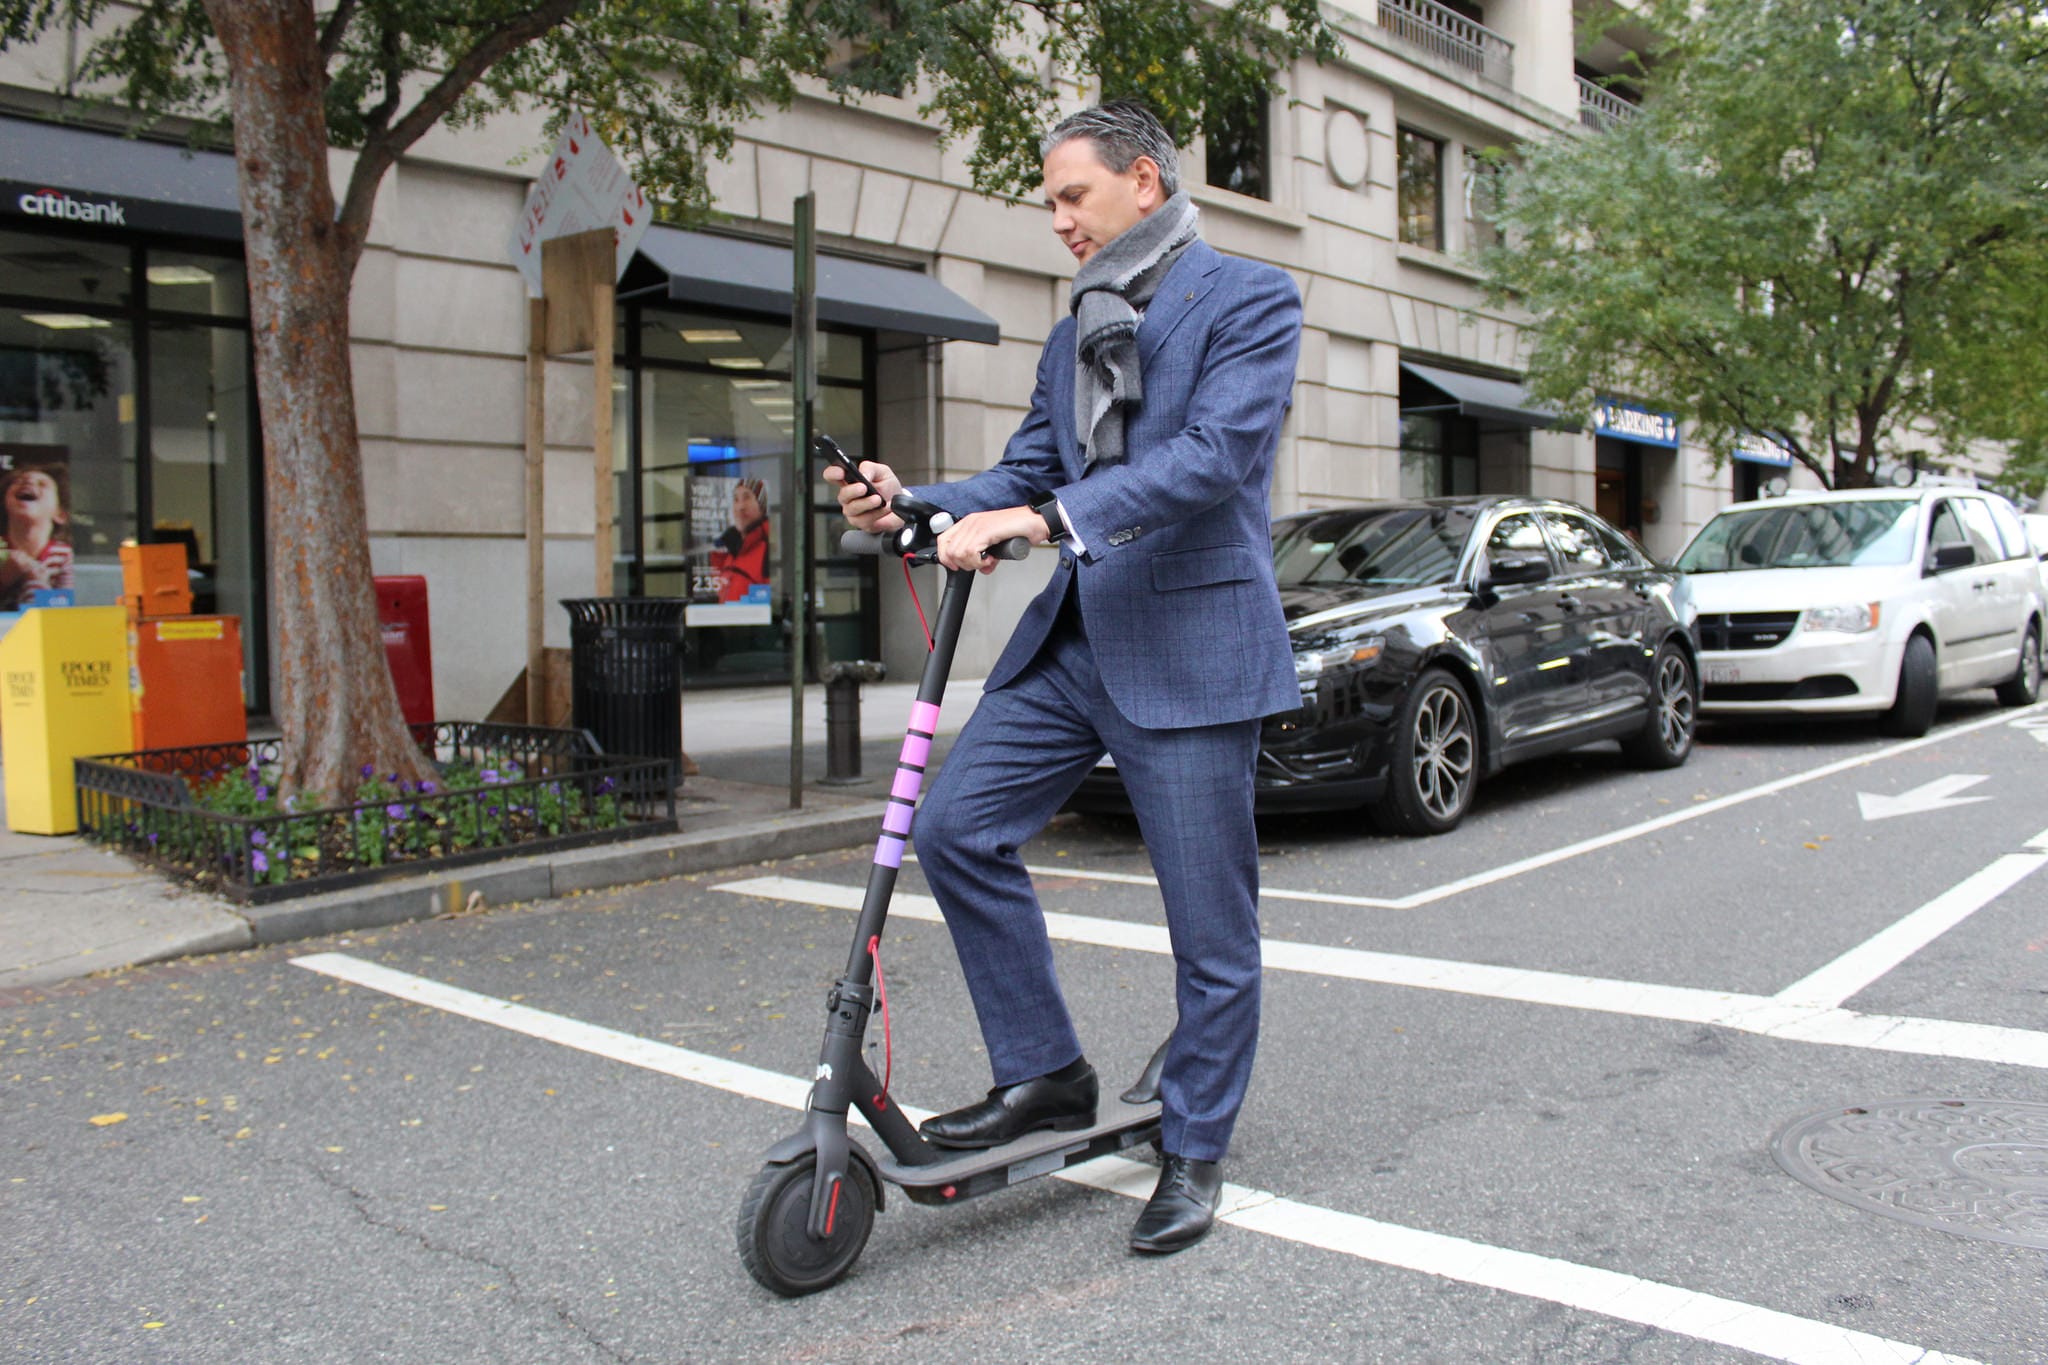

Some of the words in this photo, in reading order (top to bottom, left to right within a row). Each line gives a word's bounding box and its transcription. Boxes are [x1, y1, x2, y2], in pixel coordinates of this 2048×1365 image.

[19, 190, 126, 226] citibank
[691, 484, 714, 496] YOU
[691, 497, 717, 508] TAKE
[61, 660, 111, 674] EPOCH
[65, 674, 110, 687] TIMES
